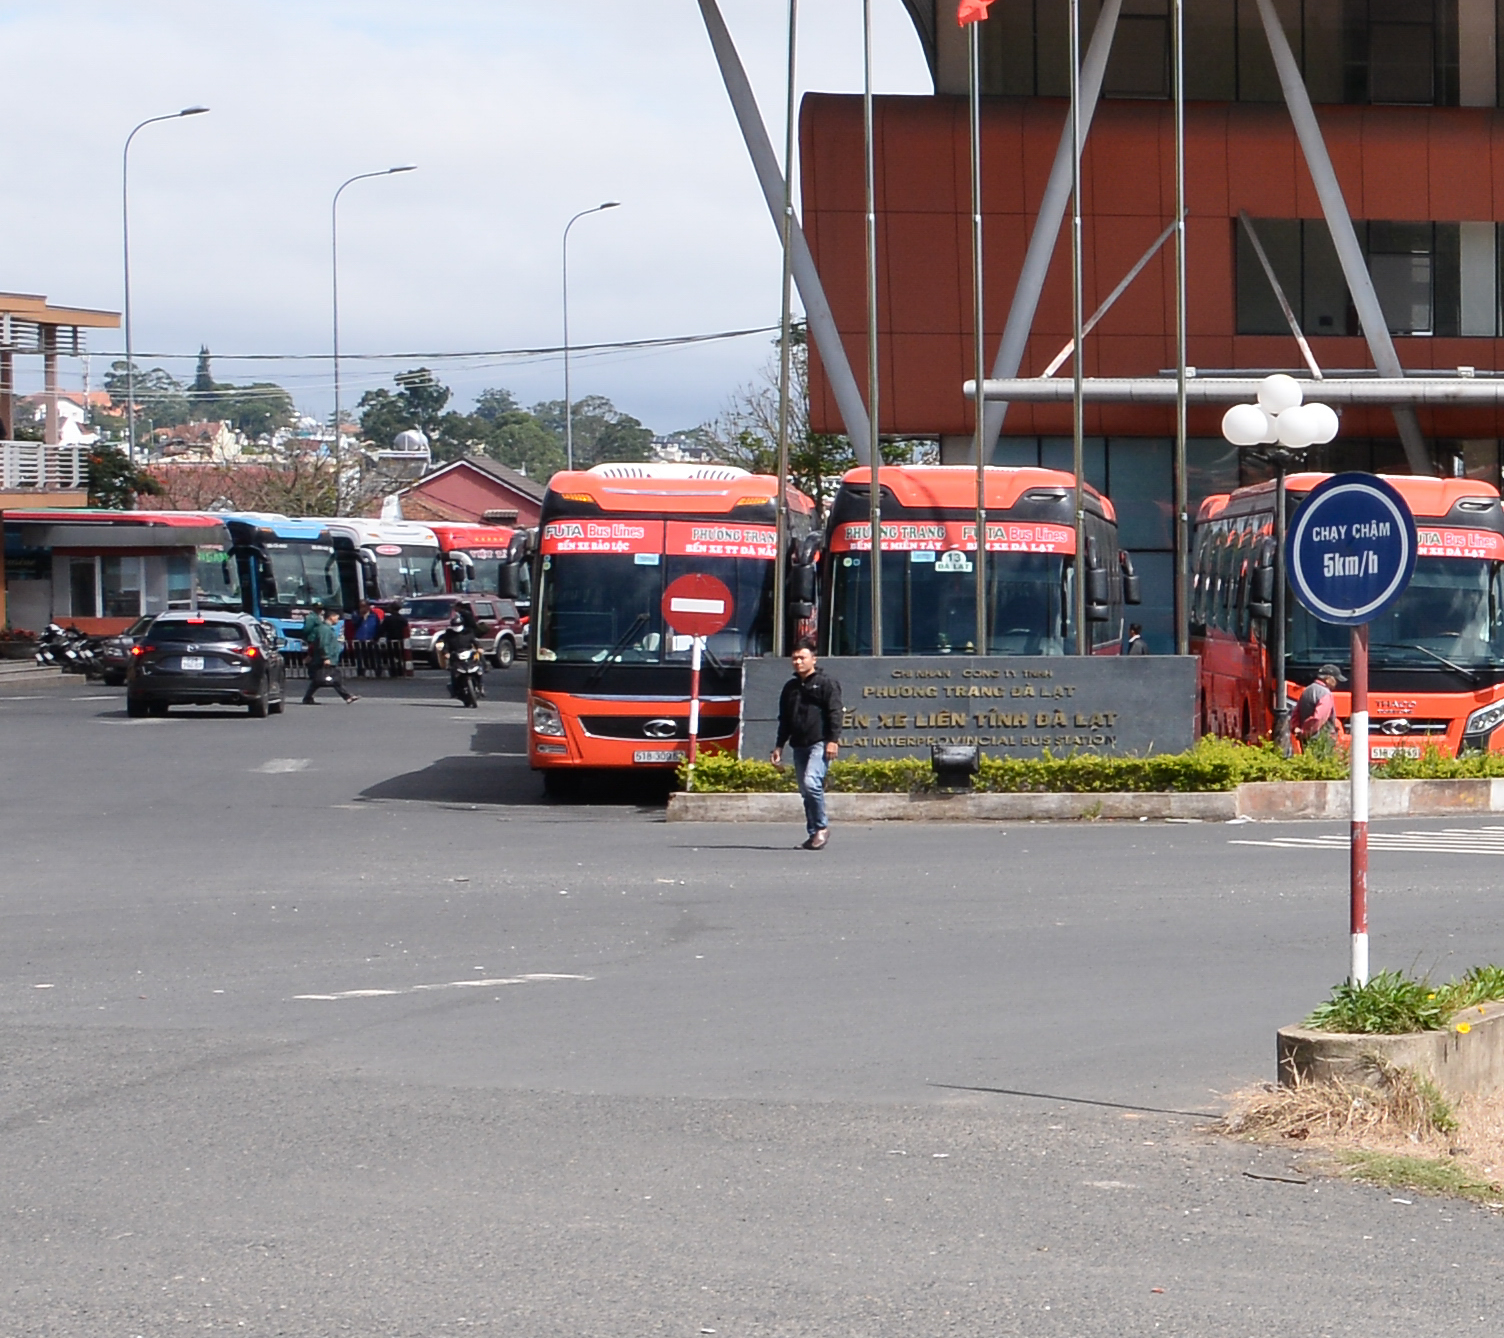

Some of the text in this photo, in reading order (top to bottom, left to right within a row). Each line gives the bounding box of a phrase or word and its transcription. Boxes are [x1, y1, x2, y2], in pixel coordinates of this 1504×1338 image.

[545, 524, 644, 539] FUTA Bus Lines
[692, 526, 776, 543] PHƯƠNG TRAN
[900, 525, 946, 540] TRANG
[1009, 526, 1033, 541] Bus
[1035, 527, 1068, 543] Lines
[1312, 520, 1390, 543] CHẠY CHẬM
[577, 542, 590, 550] XE
[686, 542, 707, 552] BẾN
[708, 545, 723, 553] XE
[725, 545, 739, 554] TT
[992, 542, 1009, 551] XE
[1444, 531, 1466, 547] Bus
[1468, 533, 1497, 549] Lines
[947, 553, 961, 562] 13
[1323, 550, 1378, 578] 5km/h
[943, 685, 1005, 698] TRANG
[1010, 682, 1035, 698] ĐÀ
[1041, 684, 1076, 700] LẠT
[842, 706, 871, 729] ẾN
[876, 712, 907, 729] XE
[915, 708, 966, 729] LIÊN
[1035, 709, 1067, 729] ĐÀ
[1074, 711, 1118, 731] LẠT
[1021, 735, 1051, 747] BUS
